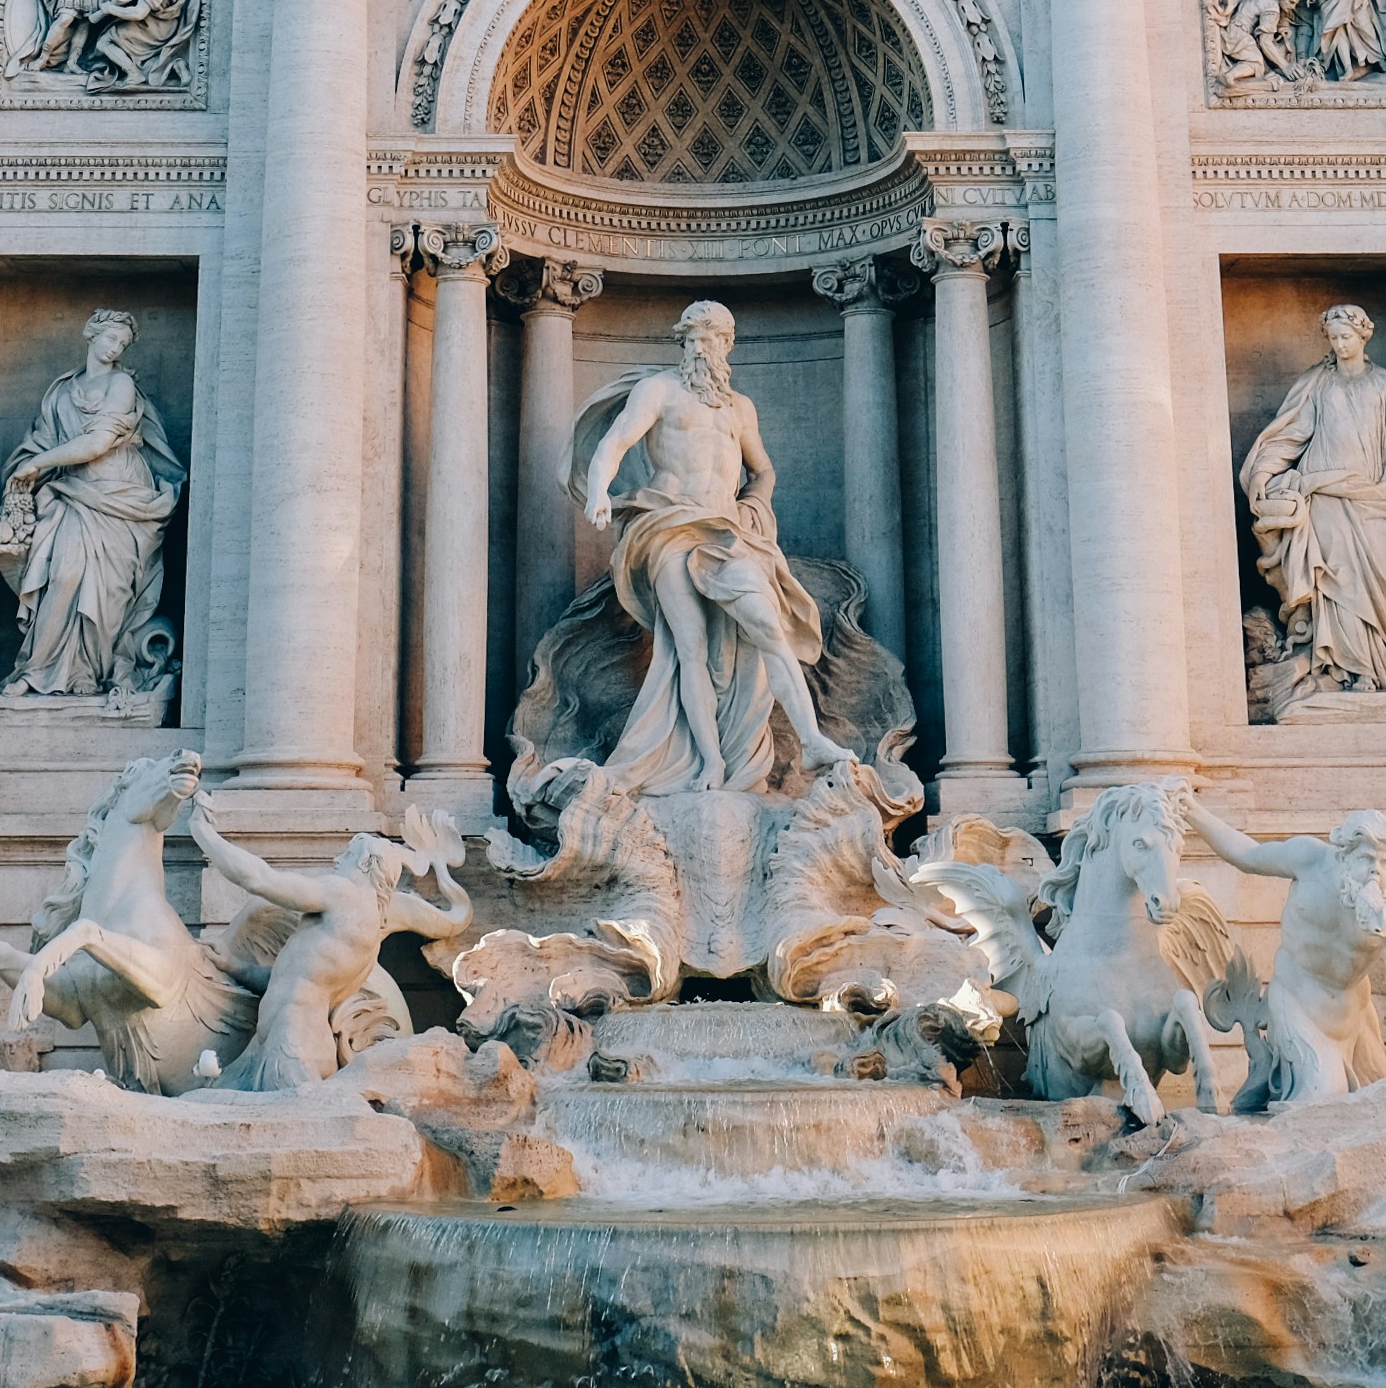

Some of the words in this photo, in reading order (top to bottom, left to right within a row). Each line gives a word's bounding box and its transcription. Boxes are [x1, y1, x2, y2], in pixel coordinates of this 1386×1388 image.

[48, 192, 114, 210] SIGNIS
[130, 192, 154, 210] ET
[169, 192, 221, 210] ANA
[366, 187, 449, 208] GLYPHIS
[1027, 183, 1056, 201] AB
[1192, 191, 1283, 209] SOLVTVM
[502, 211, 537, 237] IVSSV
[870, 214, 902, 239] OPVS
